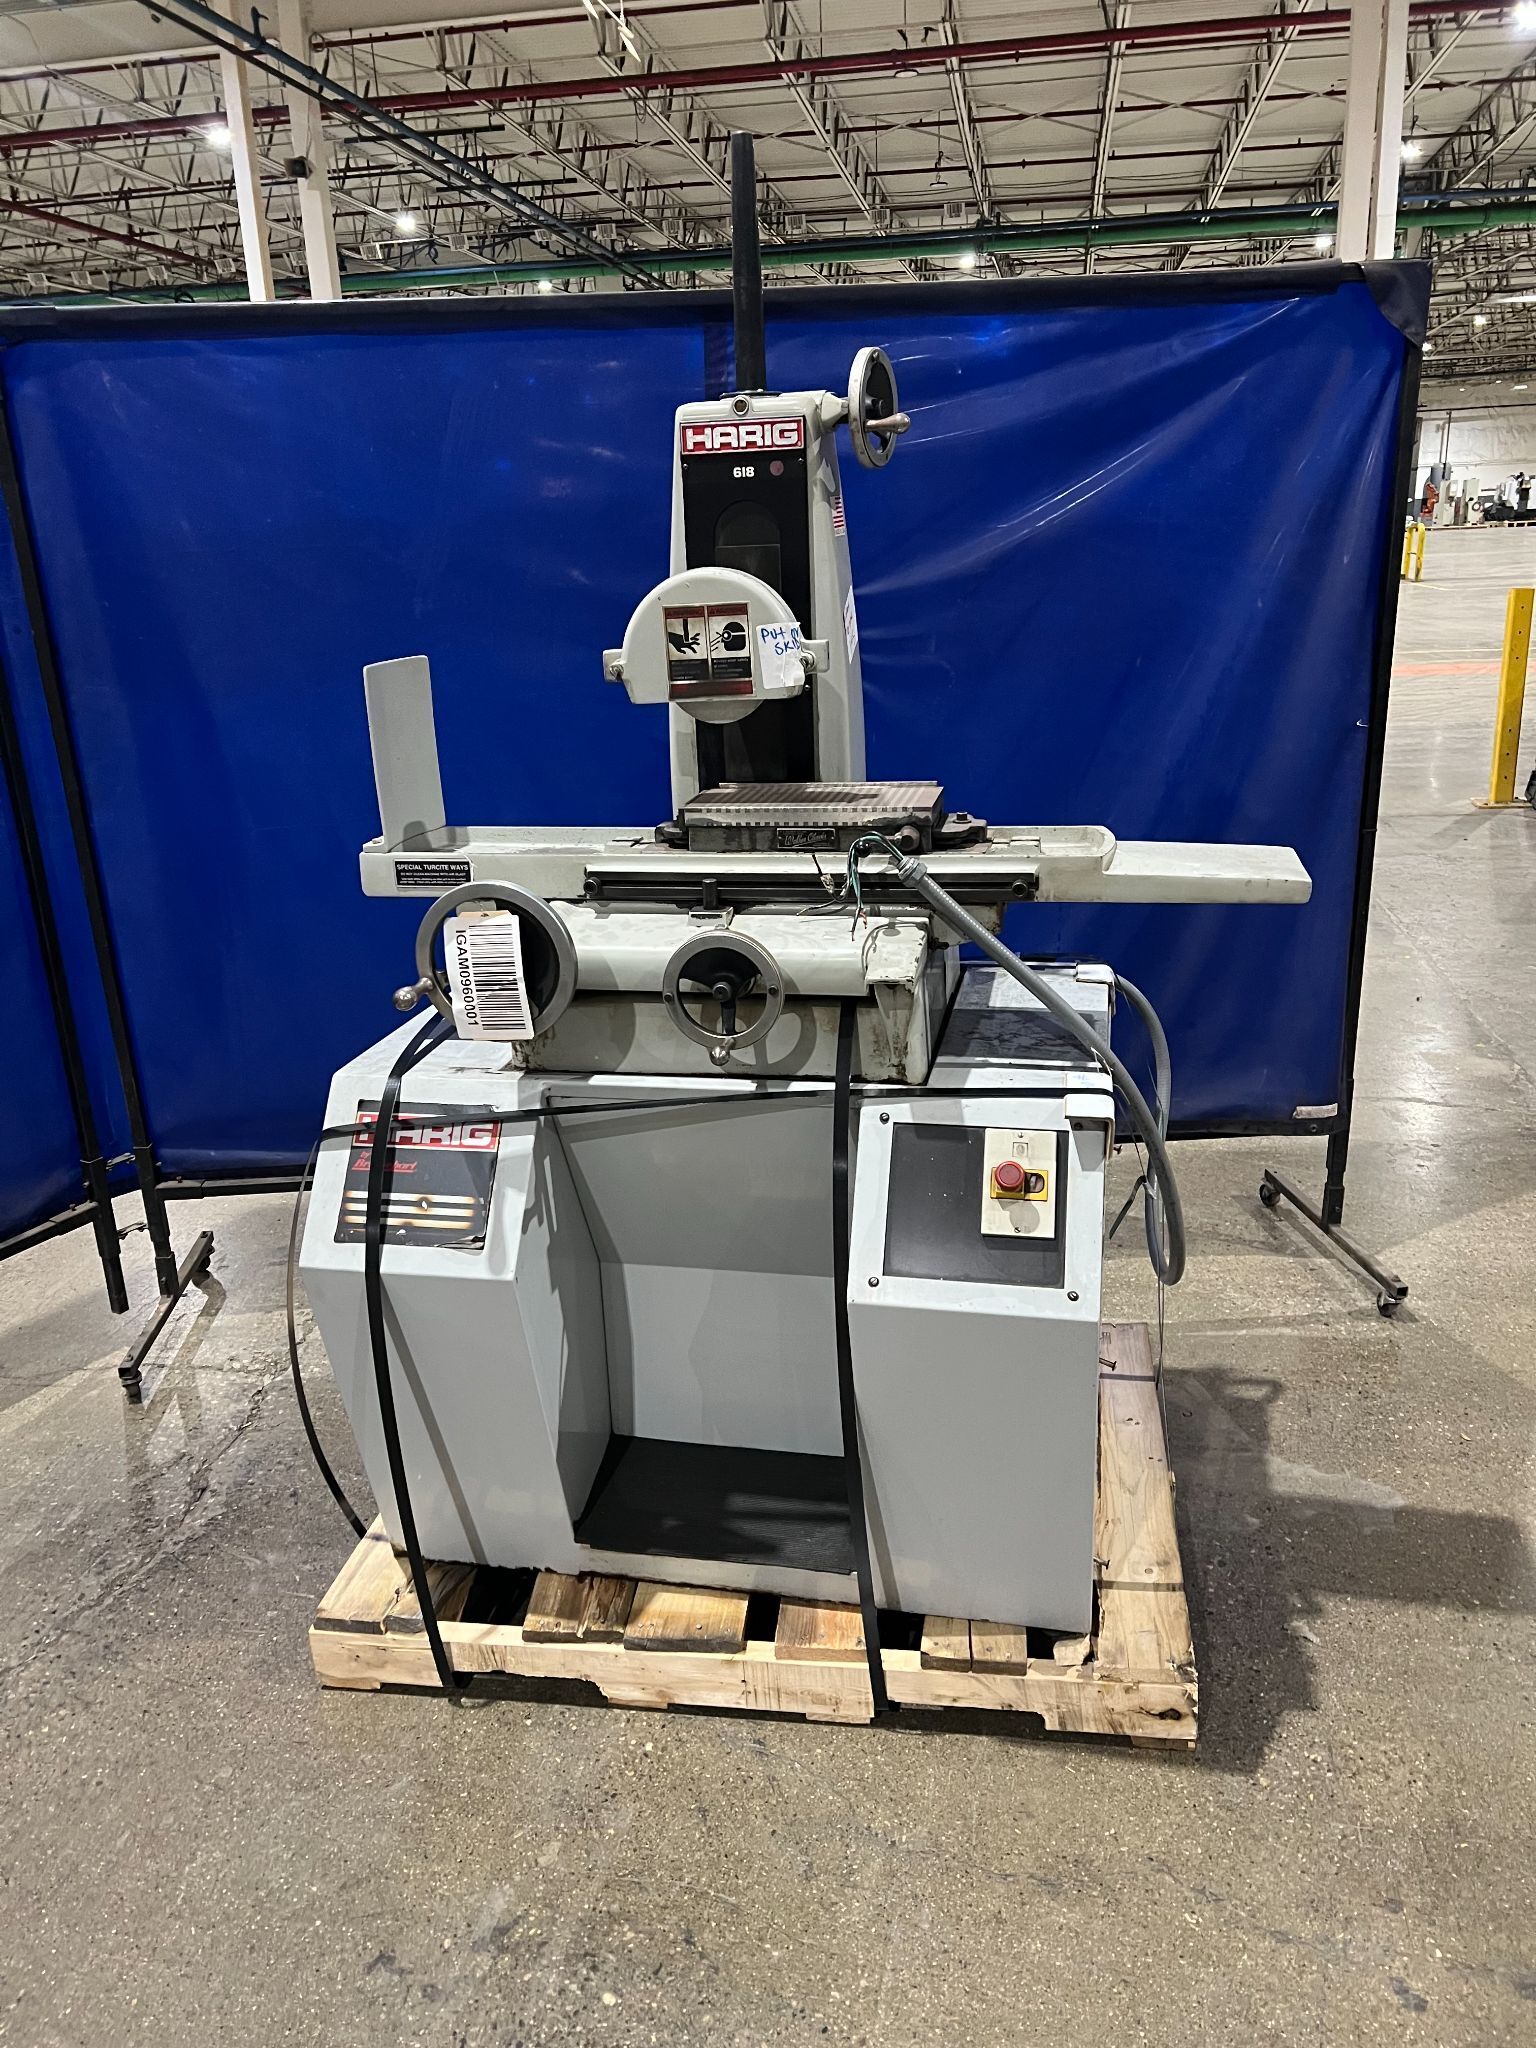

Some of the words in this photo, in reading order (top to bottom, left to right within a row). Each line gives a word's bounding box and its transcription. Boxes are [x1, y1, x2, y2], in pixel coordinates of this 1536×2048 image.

[685, 422, 798, 450] HARIG
[733, 466, 755, 478] 618
[396, 863, 422, 871] SPECIAL
[423, 863, 449, 871] TURCITE
[449, 863, 469, 871] WAYS
[455, 929, 479, 1026] IGAM0960001
